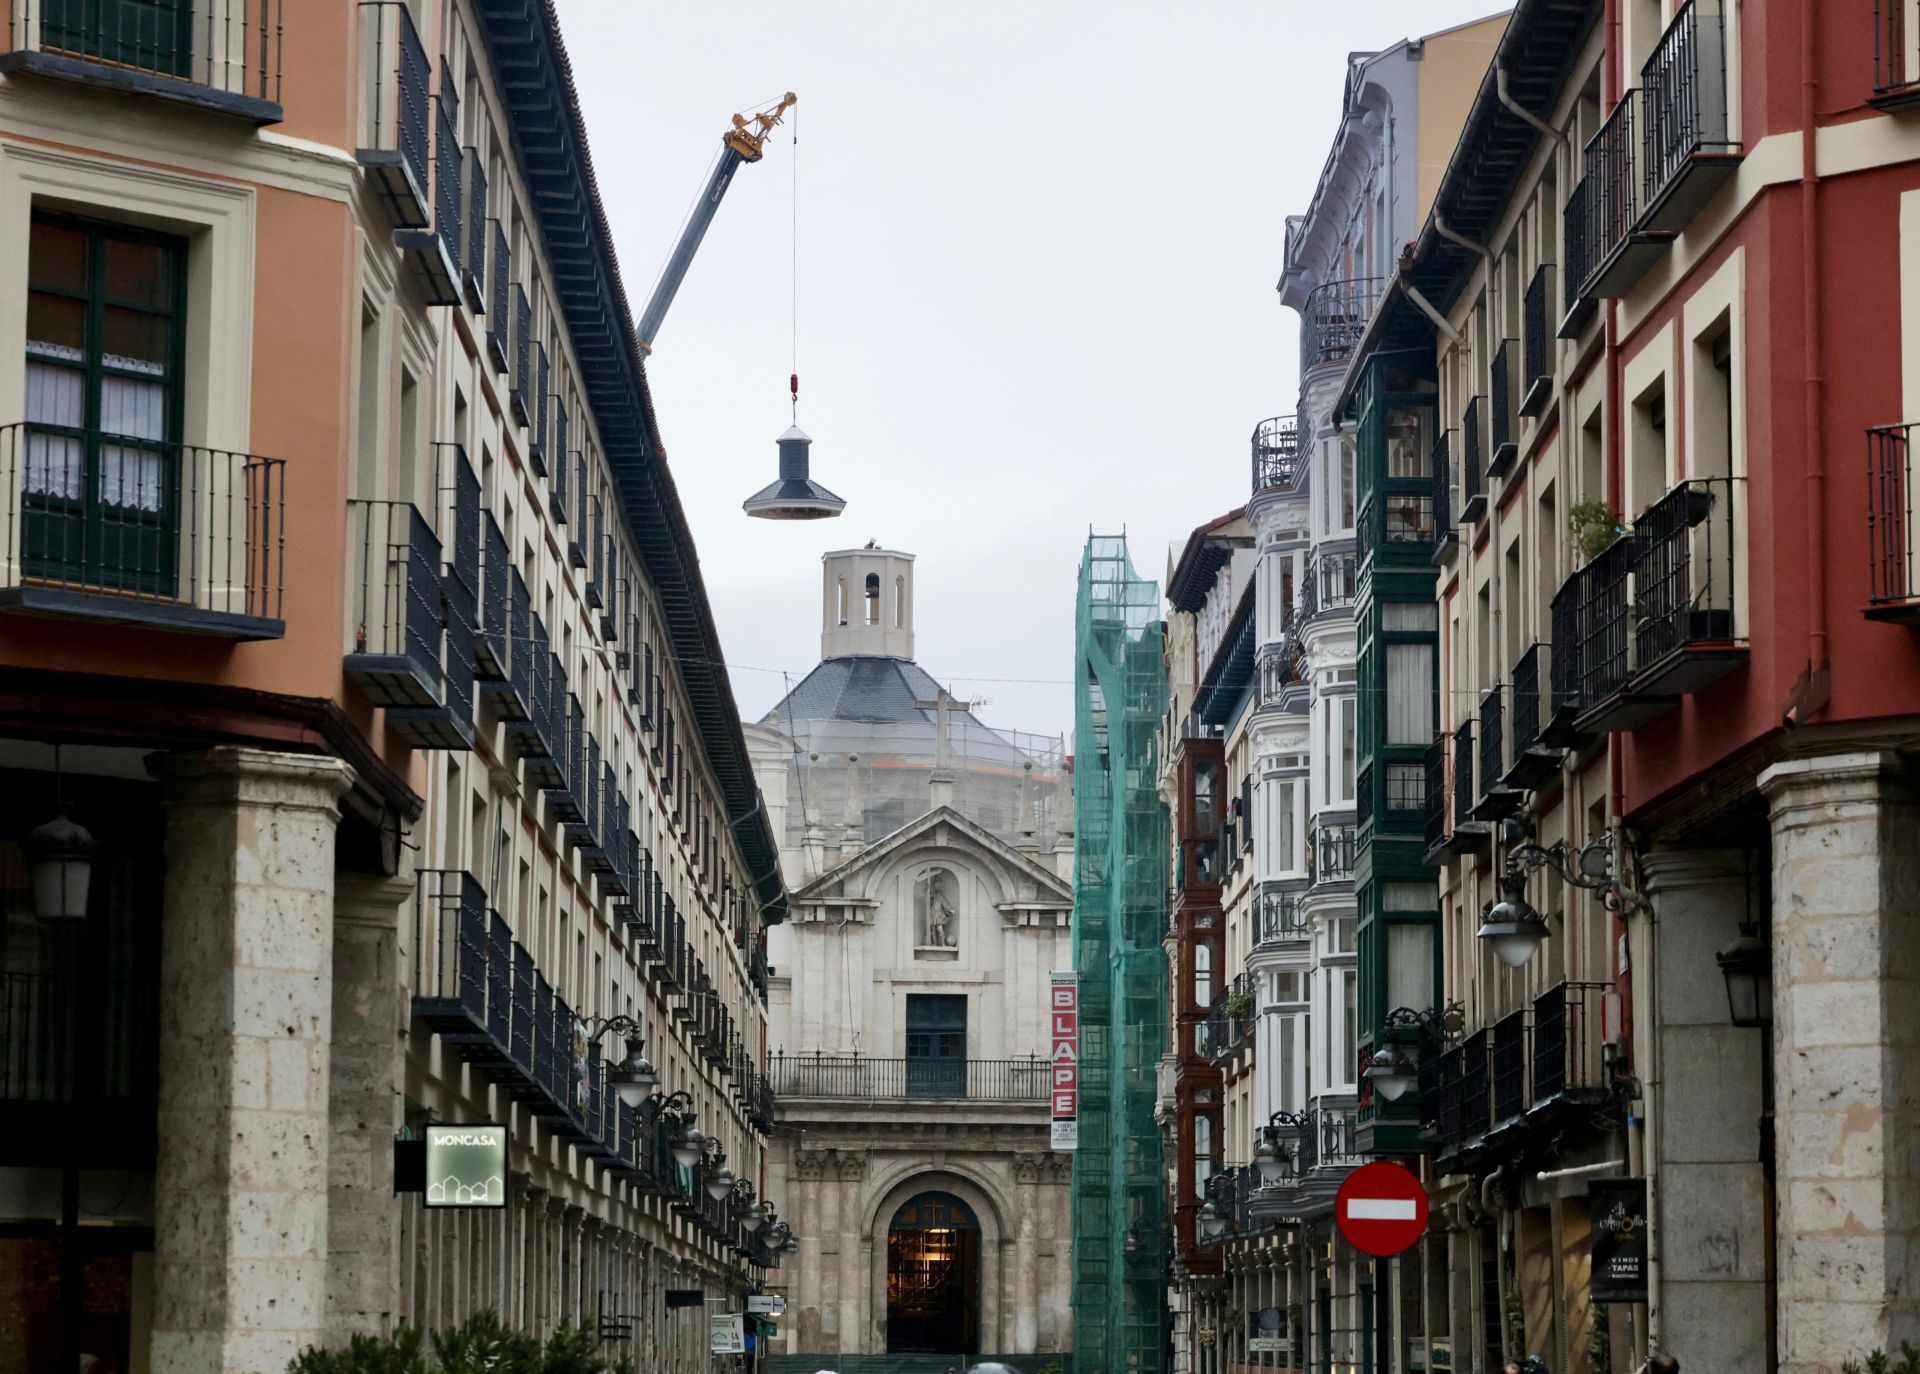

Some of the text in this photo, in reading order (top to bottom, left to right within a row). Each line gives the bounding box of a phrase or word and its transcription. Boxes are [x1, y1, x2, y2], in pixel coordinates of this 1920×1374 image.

[1053, 991, 1076, 1112] BLAPE
[434, 1135, 496, 1146] MONCASA
[1611, 1264, 1639, 1272] TAPAS
